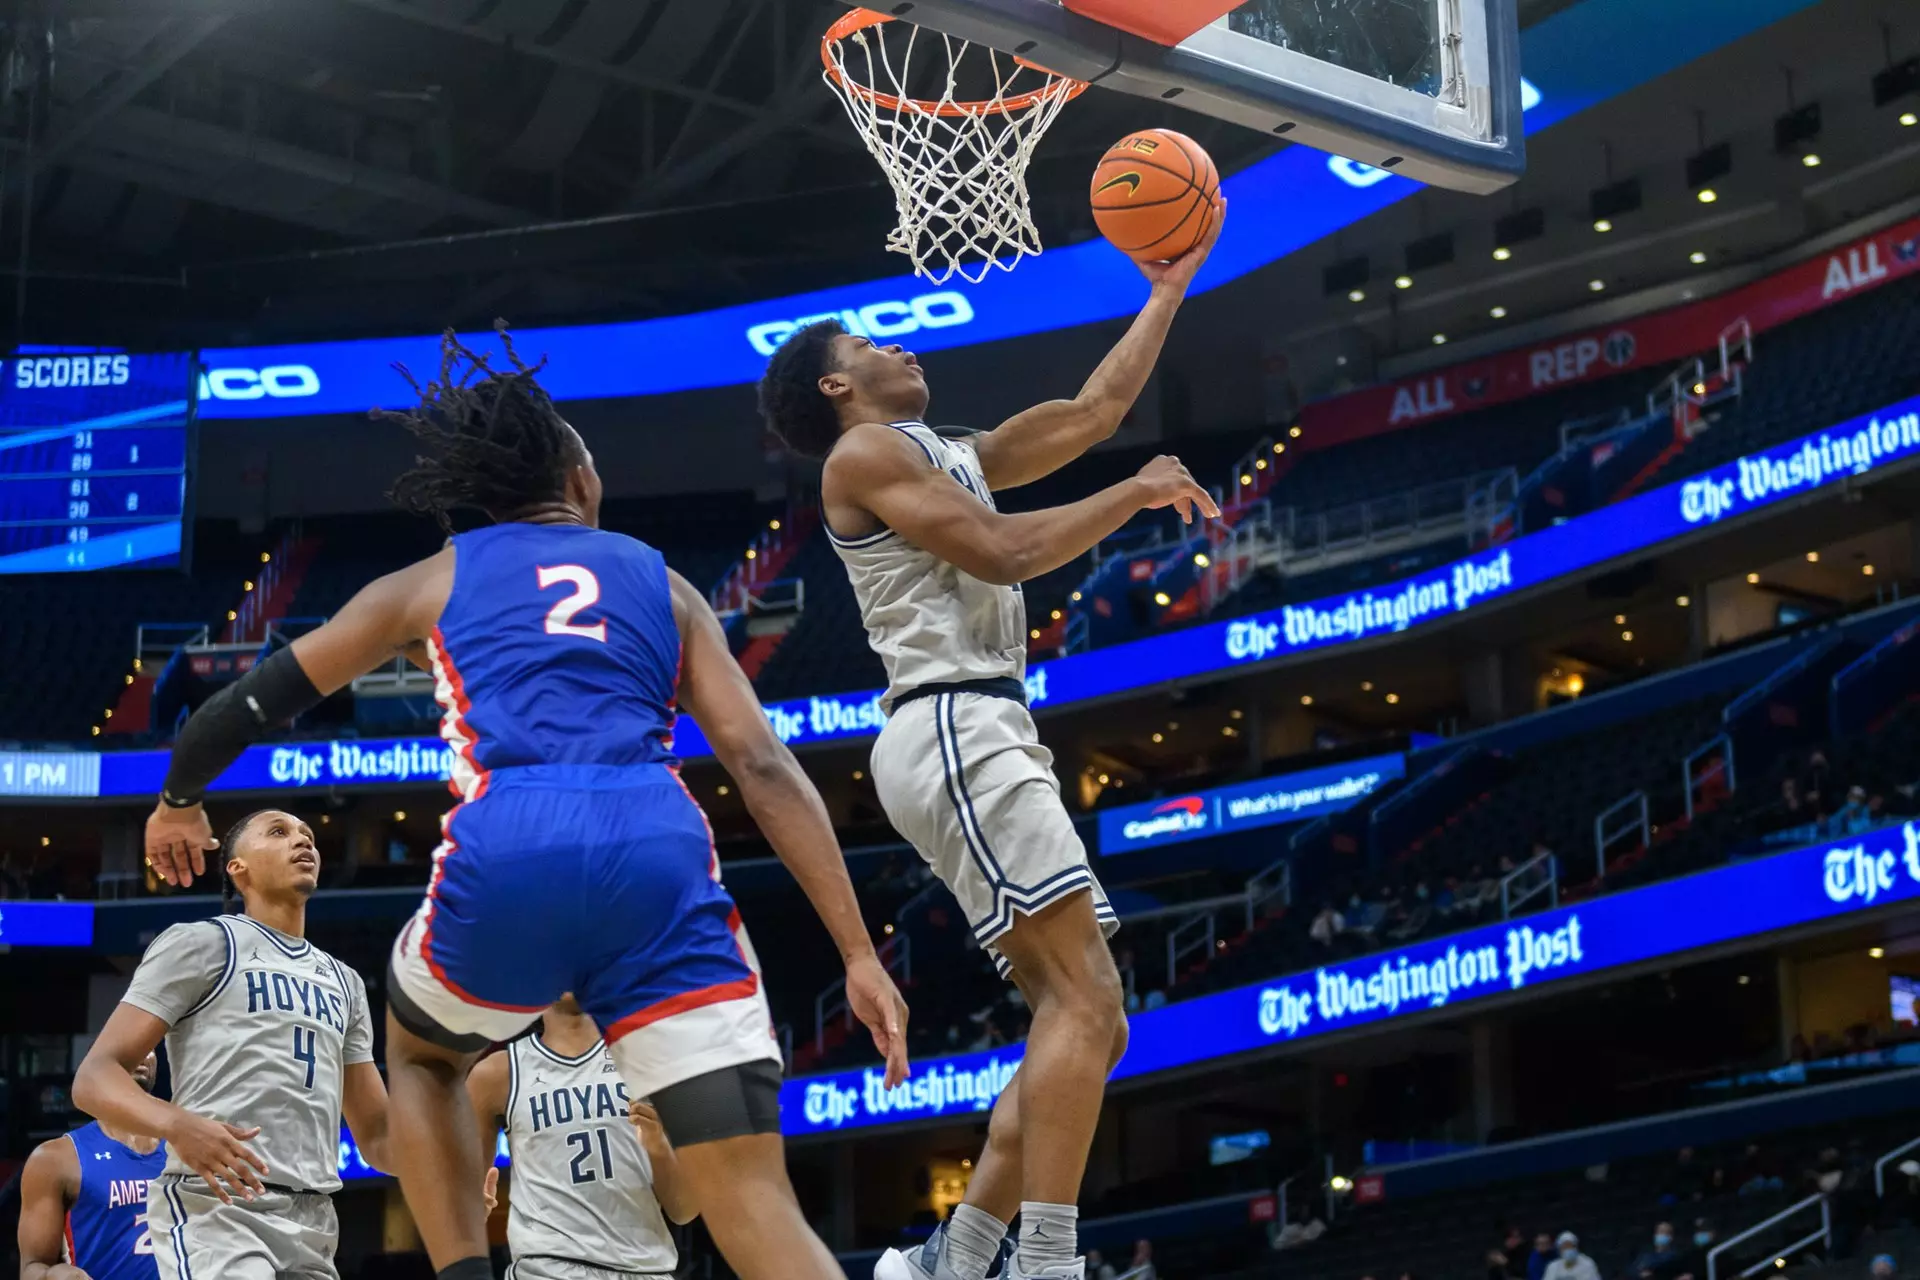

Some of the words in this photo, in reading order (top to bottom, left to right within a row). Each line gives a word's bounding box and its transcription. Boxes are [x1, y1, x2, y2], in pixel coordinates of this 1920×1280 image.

[1822, 241, 1888, 300] ALL
[16, 354, 129, 389] SCORES
[1530, 338, 1600, 388] REP
[1389, 376, 1454, 424] ALL
[1681, 475, 1734, 523] The
[1737, 413, 1920, 501] Washington
[535, 563, 607, 644] 2
[1226, 619, 1279, 660] The
[1282, 580, 1448, 645] Washington
[1452, 548, 1512, 611] Post
[4, 762, 14, 786] 1
[25, 763, 67, 787] PM
[270, 747, 323, 786] The
[1824, 844, 1896, 904] The
[244, 970, 344, 1036] HOYAS
[1258, 985, 1312, 1036] The
[1316, 945, 1499, 1020] Washington
[1506, 914, 1584, 989] Post
[293, 1024, 316, 1090] 4
[529, 1082, 630, 1133] HOYAS
[804, 1080, 858, 1127] The
[566, 1128, 614, 1185] 21
[109, 1179, 155, 1210] AME
